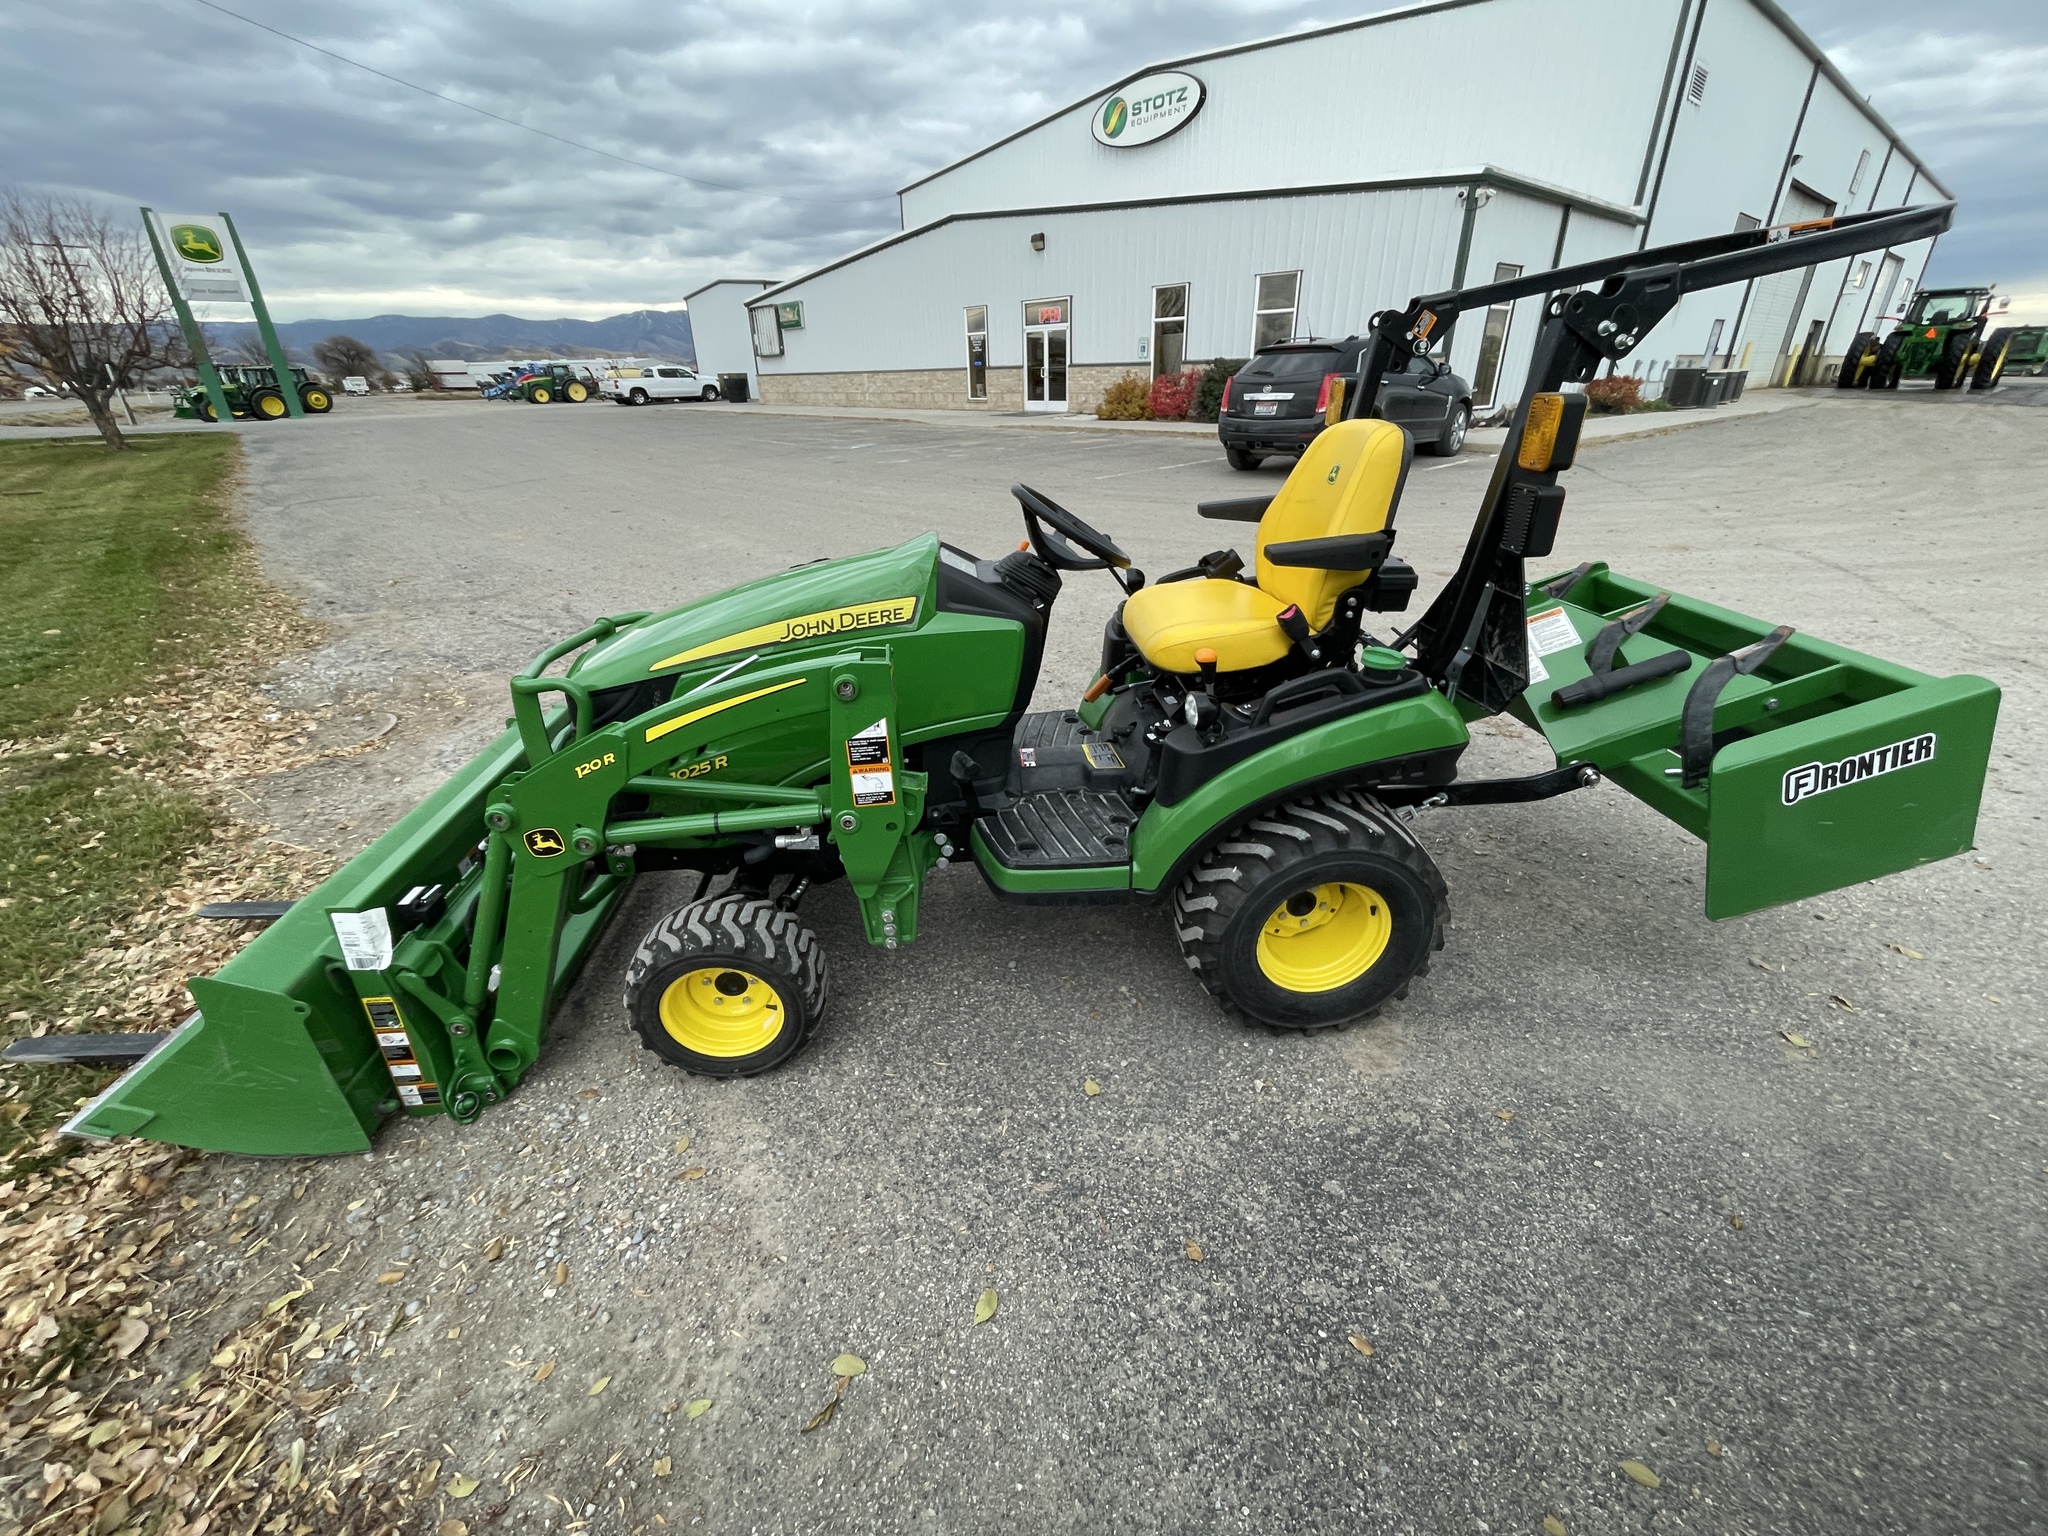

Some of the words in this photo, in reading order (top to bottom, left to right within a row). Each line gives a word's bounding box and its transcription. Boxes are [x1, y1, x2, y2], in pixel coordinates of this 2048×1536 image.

[1130, 104, 1187, 127] EQUIPMENT
[1131, 86, 1188, 117] STOTZ
[780, 618, 834, 640] JOHN
[839, 608, 905, 629] DEERE
[858, 766, 890, 774] WARNING
[1784, 734, 1934, 804] FRONTIER
